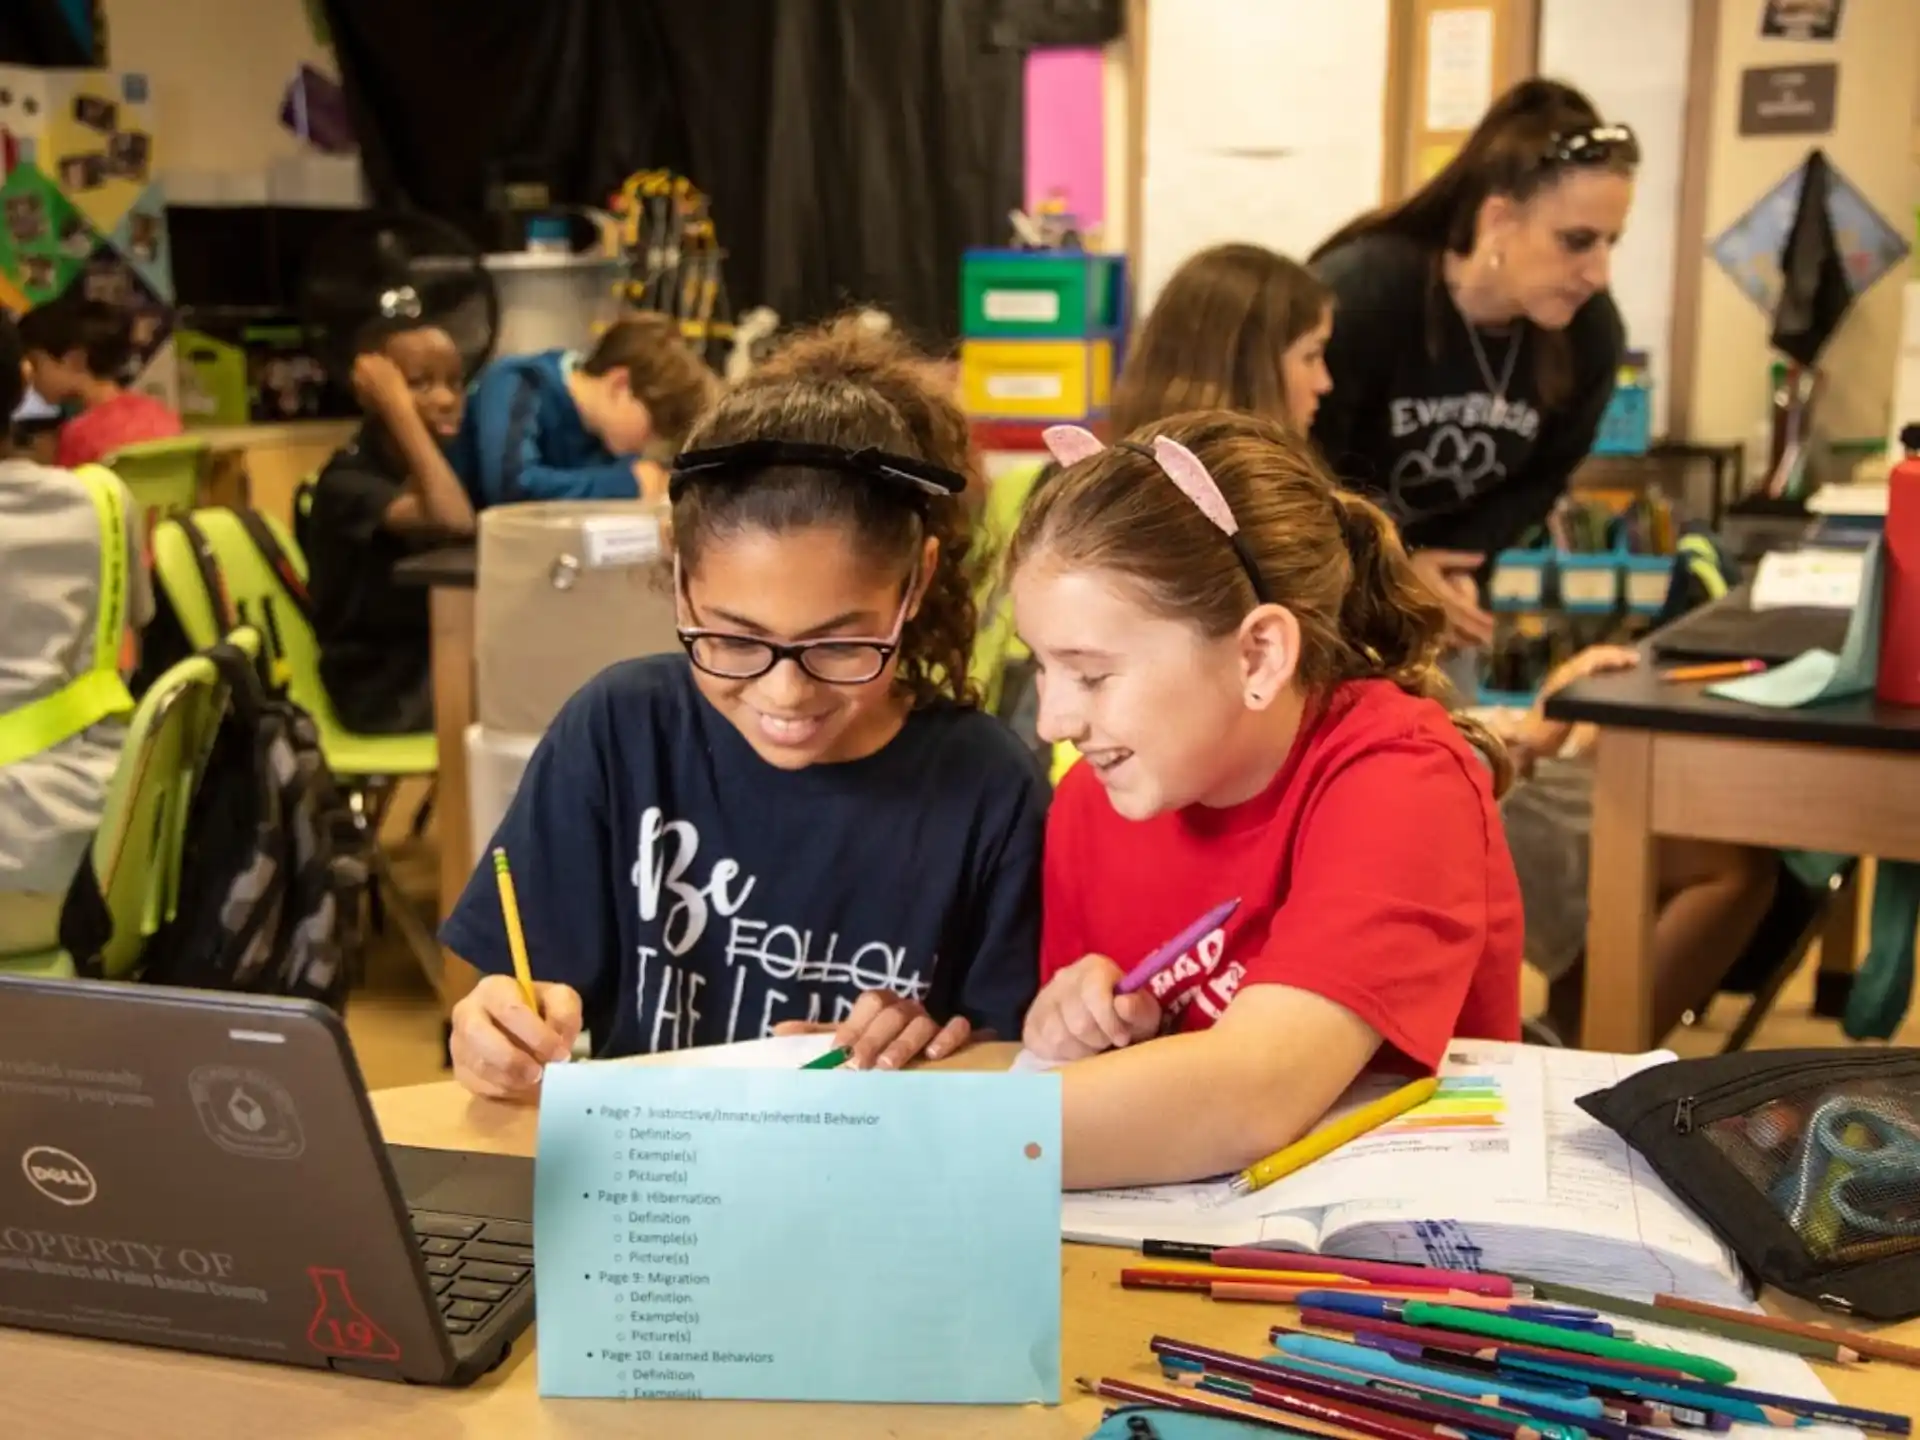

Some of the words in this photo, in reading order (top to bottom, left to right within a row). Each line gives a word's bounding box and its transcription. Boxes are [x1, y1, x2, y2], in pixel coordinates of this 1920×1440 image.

[630, 805, 756, 957] Be
[599, 1105, 630, 1120] Page
[823, 1110, 880, 1126] Behavior
[629, 1127, 691, 1141] Definition
[628, 1149, 697, 1164] Example(s)
[31, 1165, 89, 1187] DELL
[628, 1169, 688, 1185] Picture(s)
[598, 1190, 628, 1205] Page
[646, 1191, 721, 1206] Hibernation
[628, 1211, 691, 1225] Definition
[628, 1231, 698, 1246] Example(s)
[0, 1226, 166, 1271] OPERTY
[177, 1248, 236, 1279] OF
[629, 1251, 689, 1266] Picture(s)
[599, 1271, 629, 1286] Page
[647, 1272, 711, 1287] Migration
[630, 1290, 692, 1304] Definition
[630, 1310, 699, 1325] Example(s)
[325, 1317, 373, 1349] 19
[631, 1329, 691, 1344] Picture(s)
[601, 1350, 630, 1364] Page
[657, 1350, 708, 1362] Learned
[712, 1351, 774, 1364] Behaviors
[632, 1369, 695, 1382] Definition
